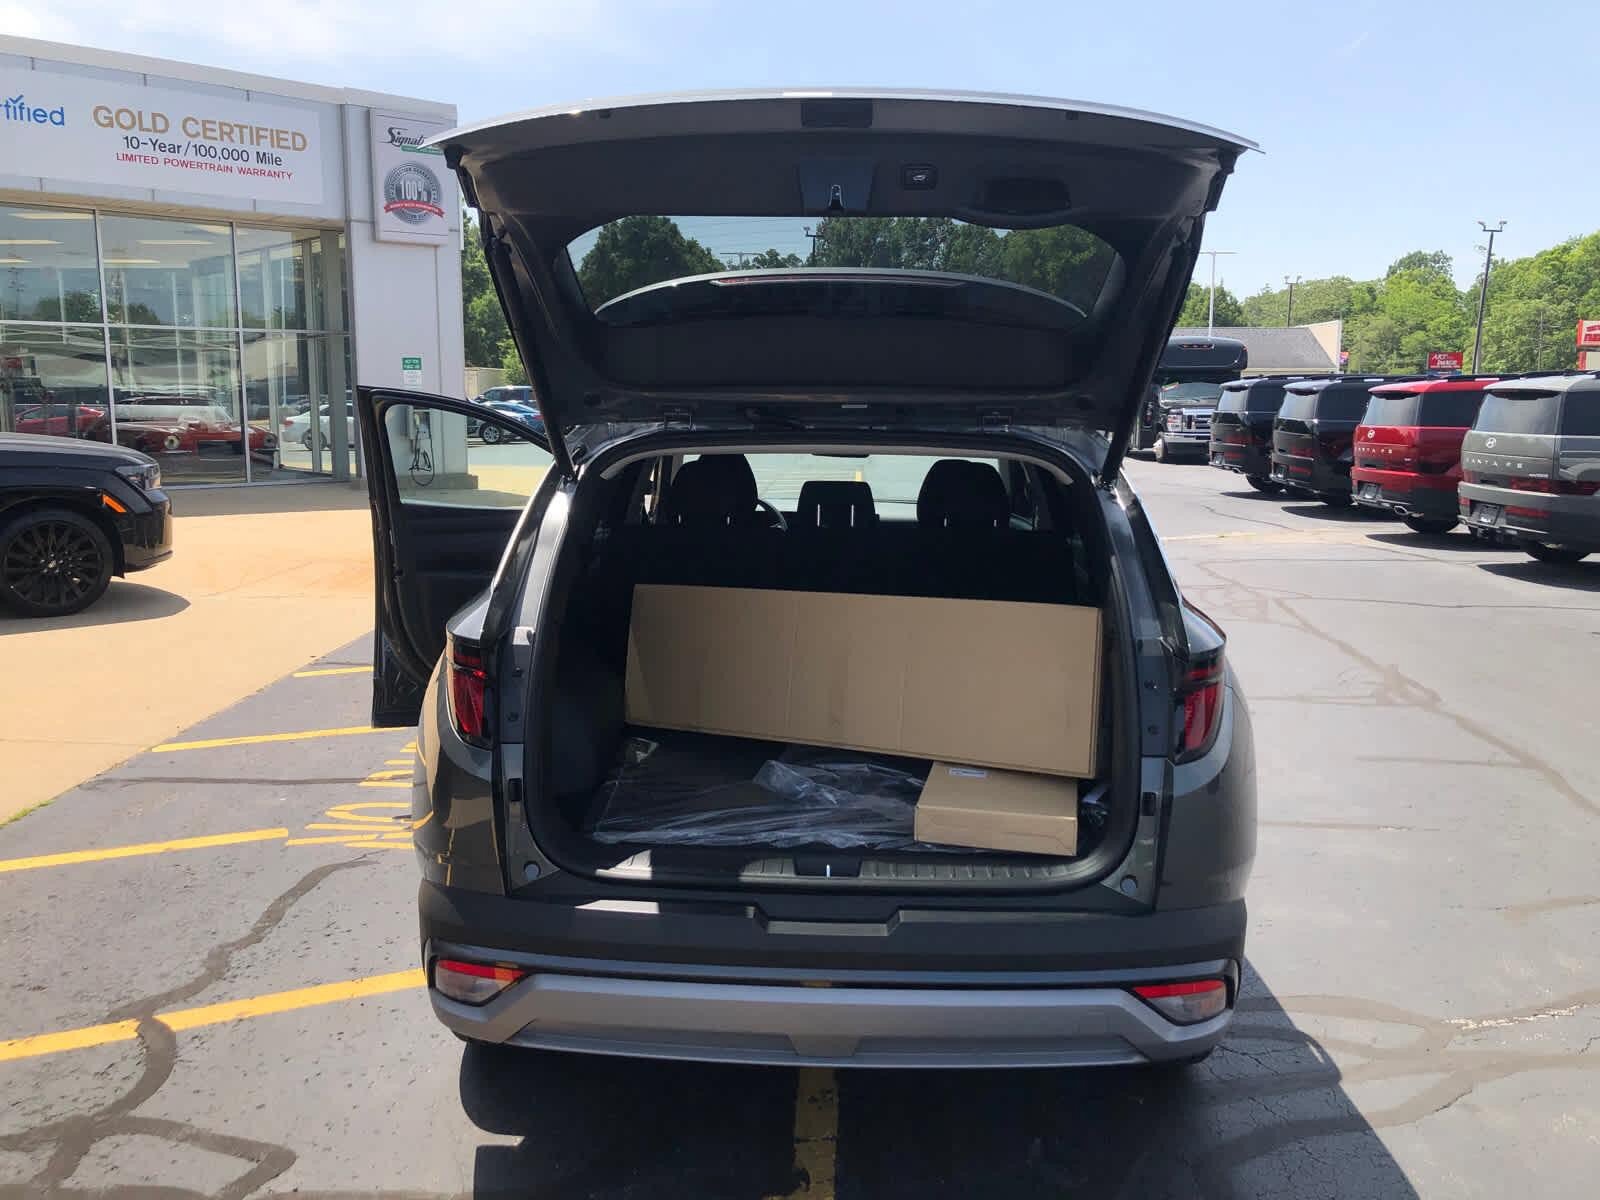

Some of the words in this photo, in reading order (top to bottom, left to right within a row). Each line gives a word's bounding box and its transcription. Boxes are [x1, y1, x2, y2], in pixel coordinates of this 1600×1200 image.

[0, 97, 65, 126] tified
[92, 105, 170, 134] GOLD
[181, 116, 308, 152] CERTIFIED
[116, 152, 159, 165] LIMITED
[163, 158, 233, 174] POWERTRAIN
[236, 166, 293, 181] WARRANTY
[255, 151, 283, 167] Mile
[399, 179, 428, 202] 100%
